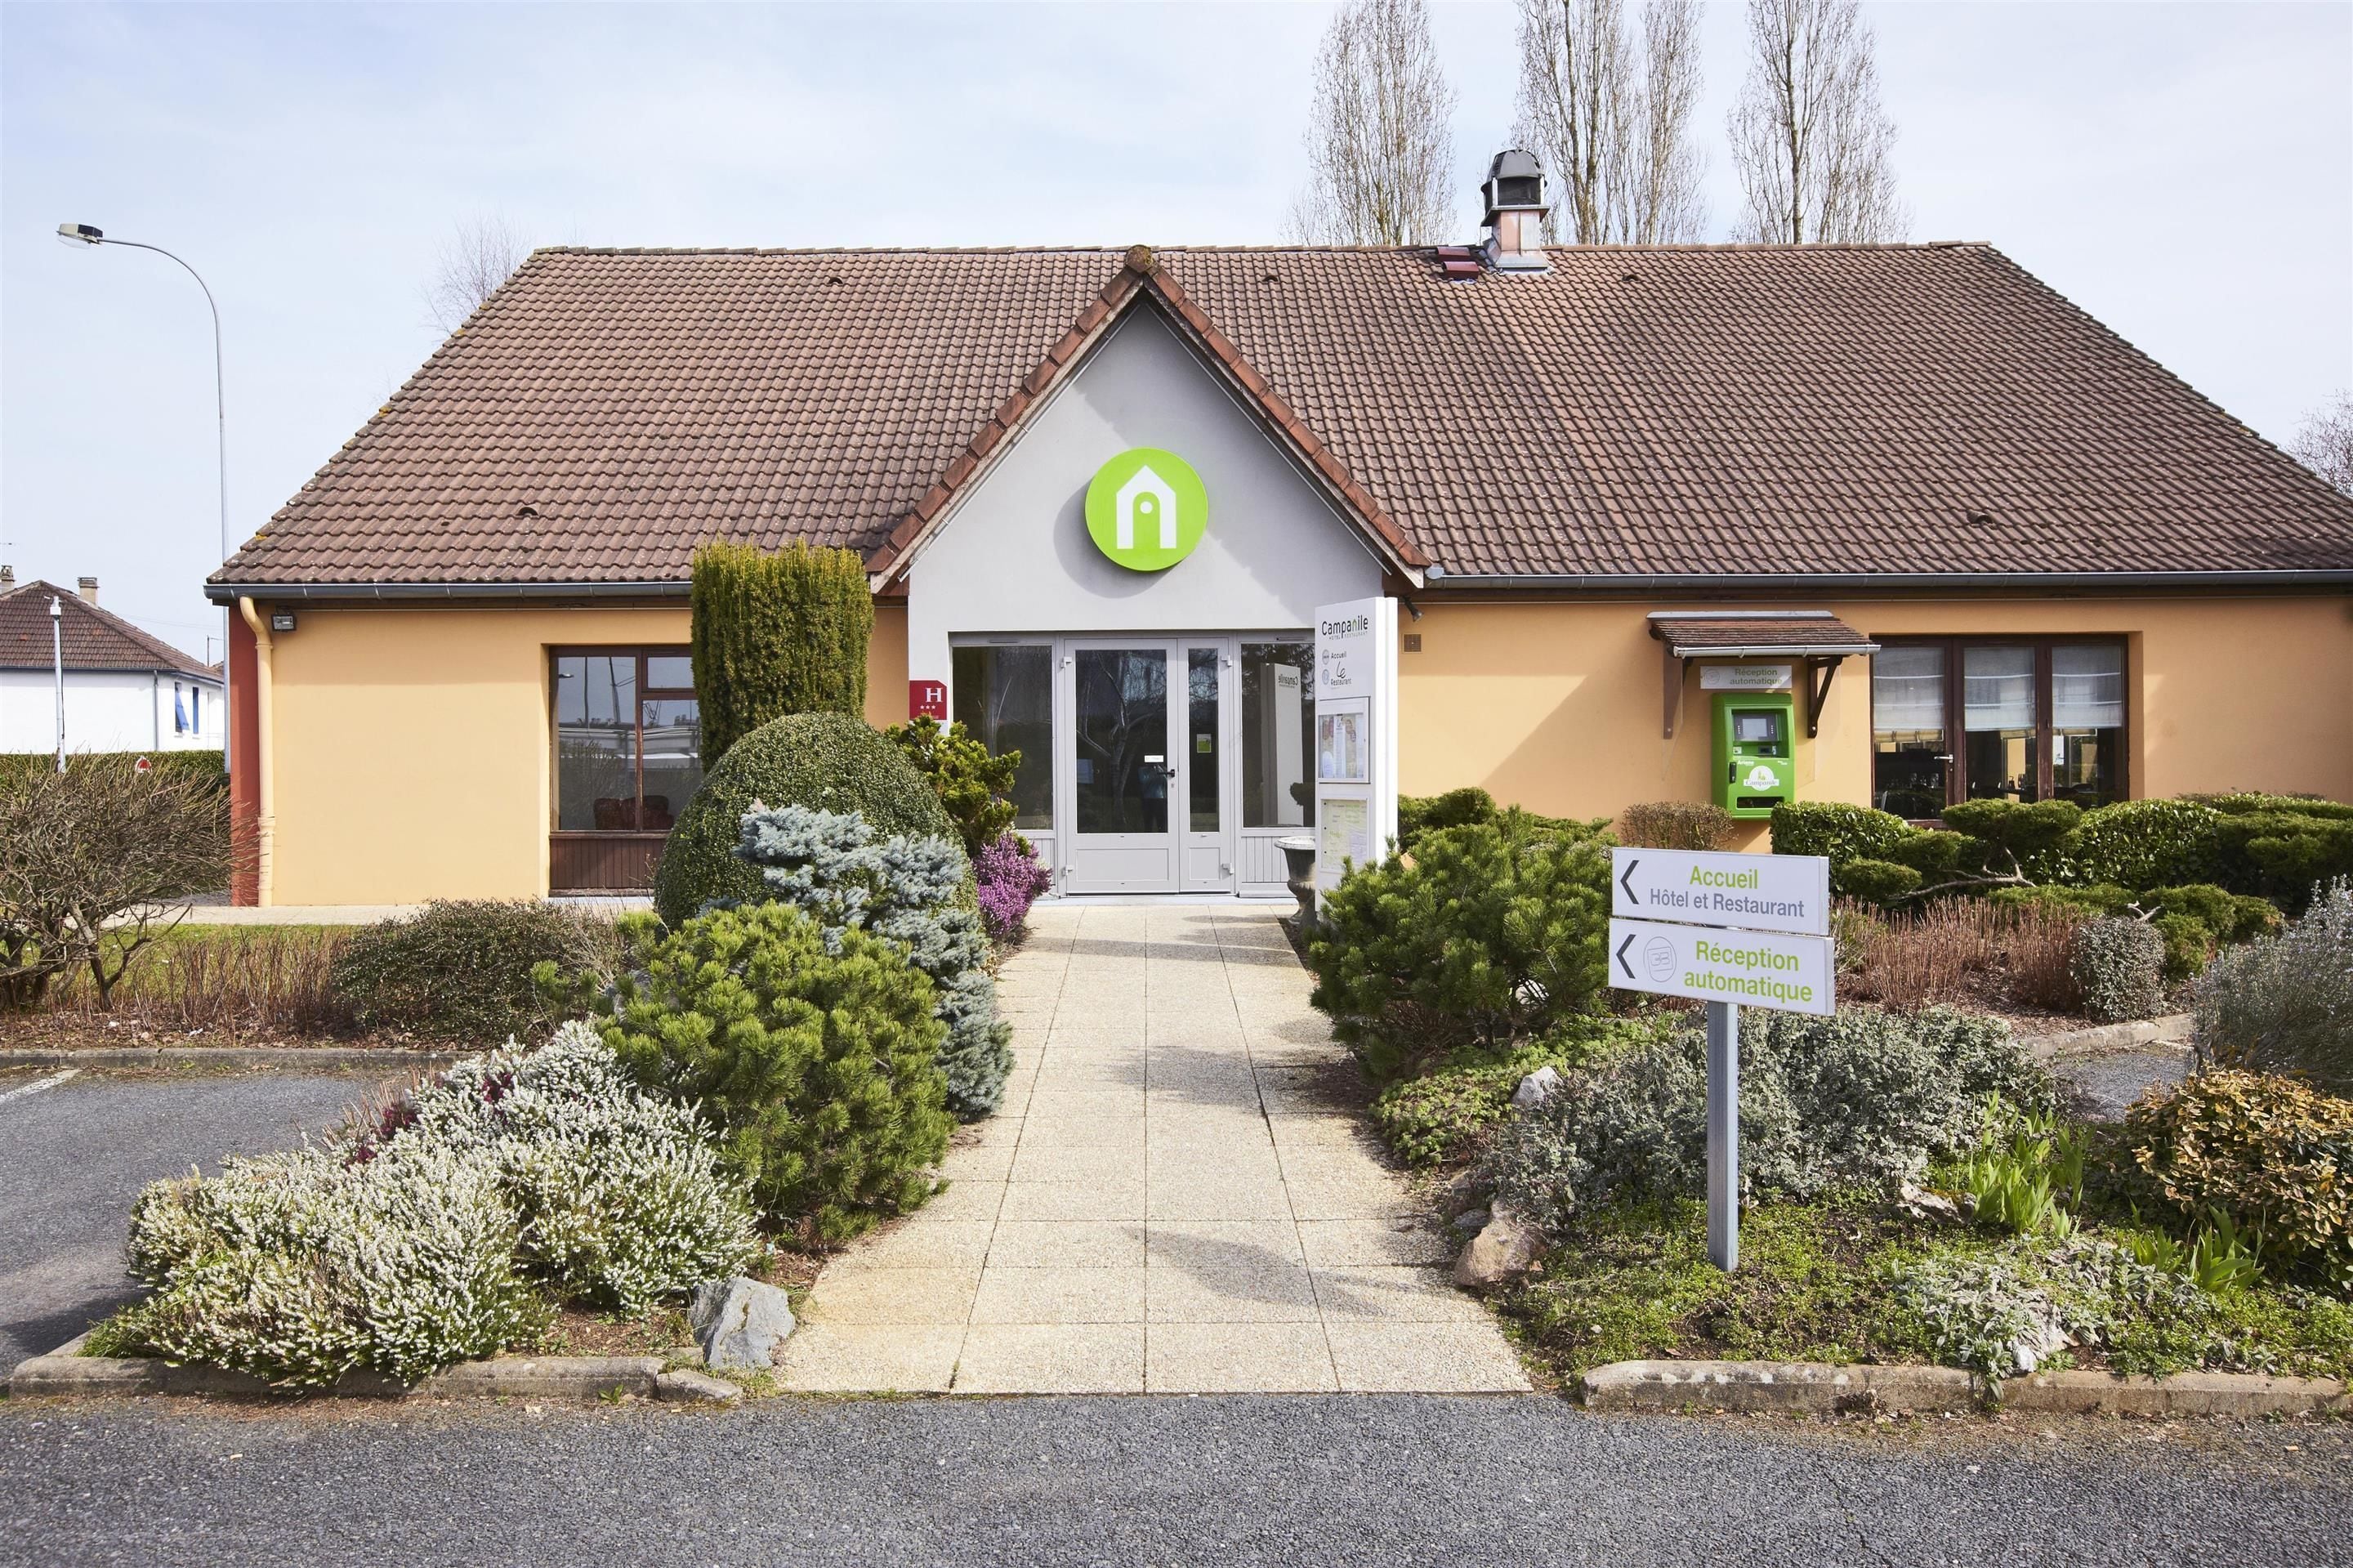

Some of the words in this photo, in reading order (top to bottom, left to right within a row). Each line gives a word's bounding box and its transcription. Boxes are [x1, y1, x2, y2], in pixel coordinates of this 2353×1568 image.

[1321, 614, 1368, 639] Campanile
[1330, 651, 1347, 659] Accueil
[1330, 678, 1352, 686] Restaurant
[1730, 677, 1783, 686] automatique
[1735, 668, 1778, 677] Réception
[925, 687, 943, 703] H
[1689, 865, 1758, 890] Accueil
[1650, 888, 1689, 908] Hôtel
[1693, 893, 1708, 909] et
[1713, 893, 1805, 918] Restaurant
[1696, 940, 1799, 972] Réception
[1684, 971, 1813, 1003] automatique
